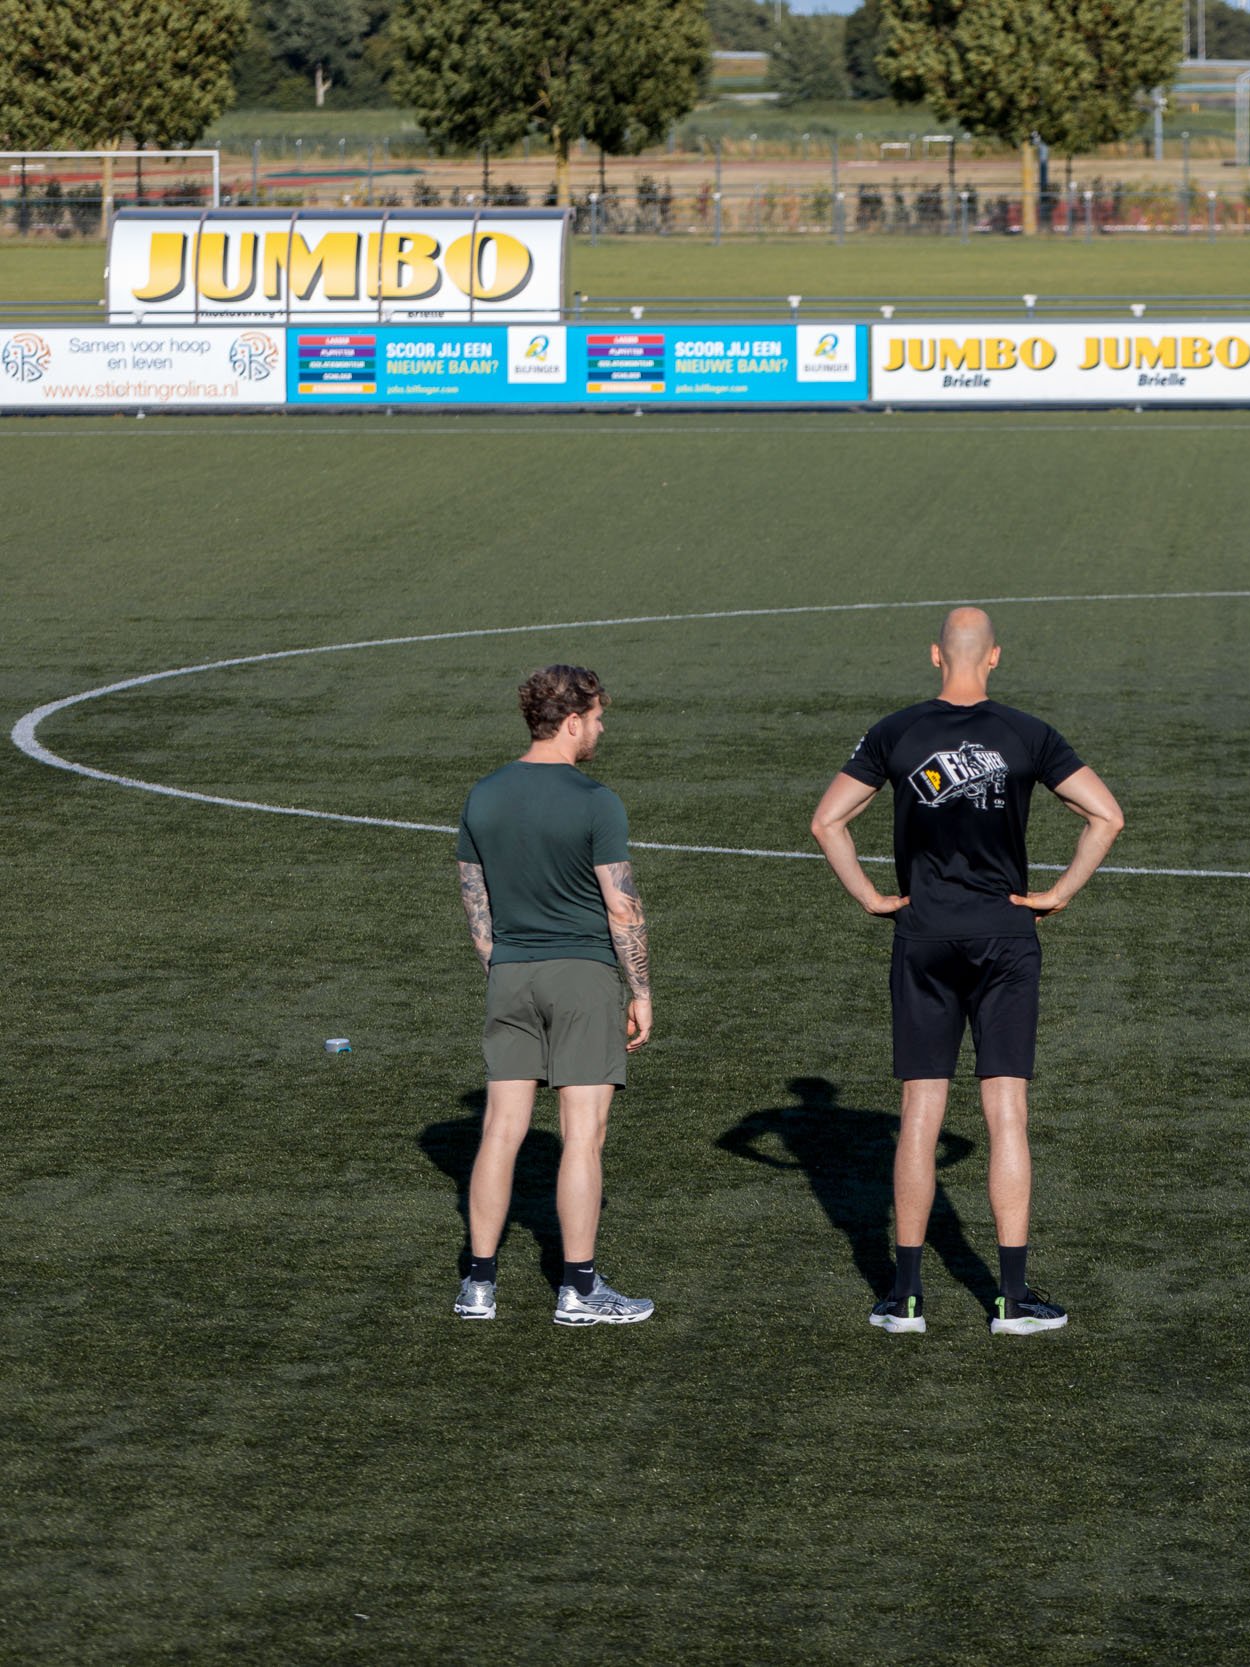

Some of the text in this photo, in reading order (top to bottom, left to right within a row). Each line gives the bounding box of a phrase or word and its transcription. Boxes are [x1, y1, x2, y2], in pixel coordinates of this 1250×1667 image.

[131, 231, 534, 303] JUMBO
[68, 337, 211, 357] Samen voor hoop
[386, 342, 492, 358] SCOOR JIJ EEN
[675, 341, 782, 357] SCOOR JIJ EEN
[883, 337, 1057, 371] JUMBO
[107, 355, 173, 370] en leven
[387, 359, 499, 375] NIEUWE BAAN?
[514, 364, 561, 374] BILFINGER
[675, 358, 788, 374] NIEUWE BAAN?
[943, 375, 991, 388] Brielle
[1138, 374, 1186, 387] Brielle
[43, 380, 239, 402] www.stichtingrolina.nl
